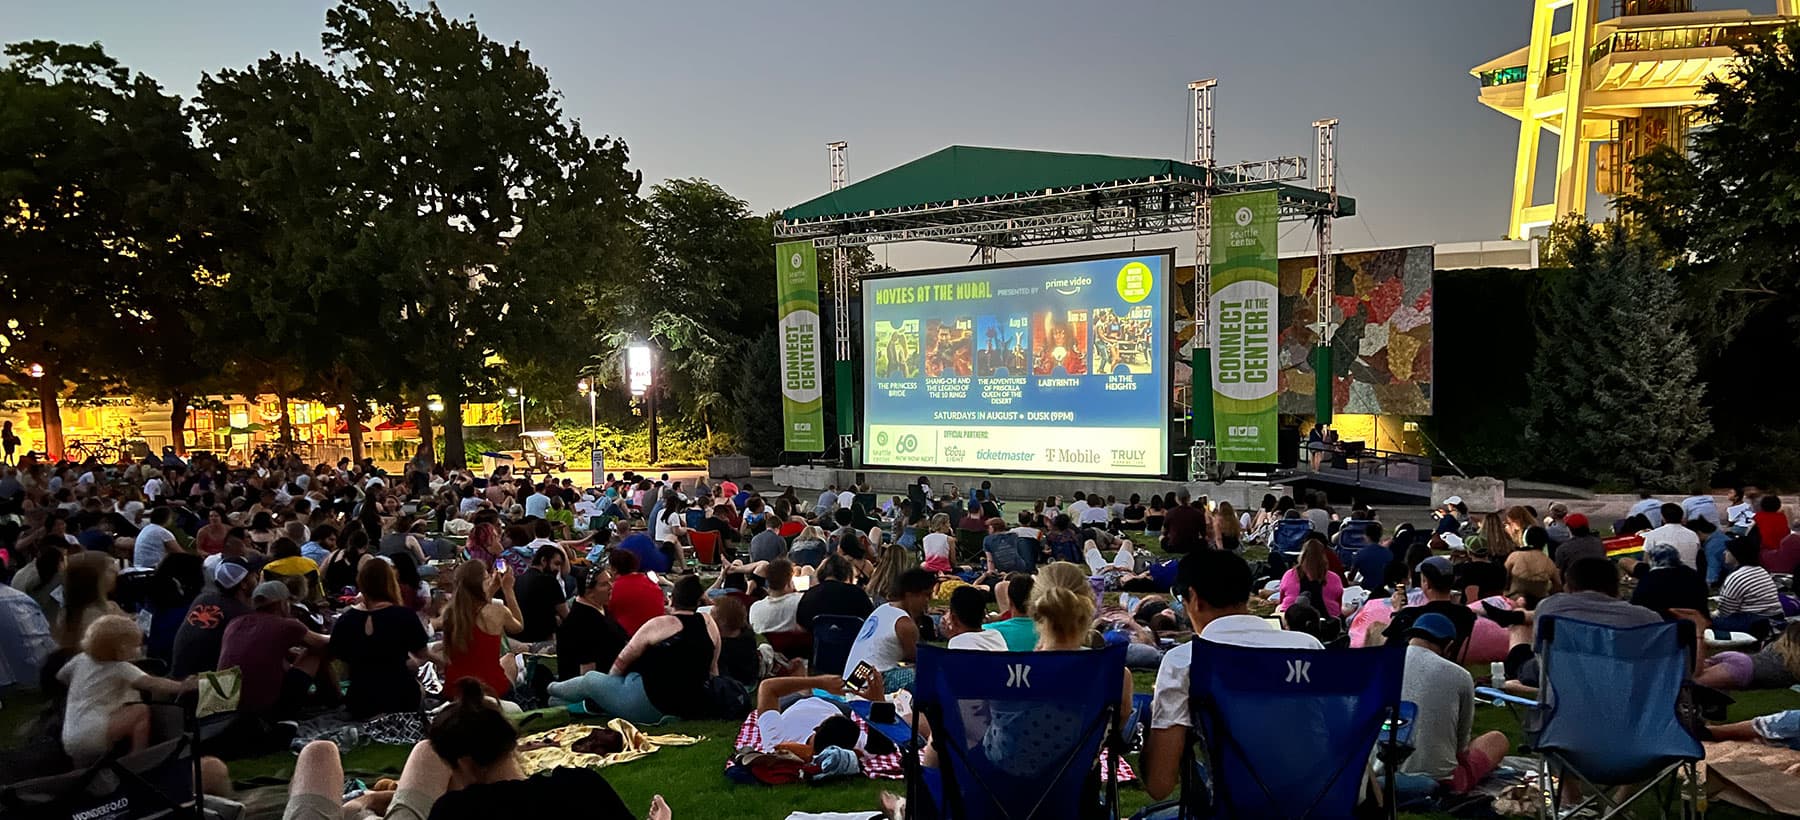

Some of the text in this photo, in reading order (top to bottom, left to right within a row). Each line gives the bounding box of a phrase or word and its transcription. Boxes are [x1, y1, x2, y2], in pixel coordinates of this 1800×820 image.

[1230, 227, 1258, 239] seattle
[1230, 238, 1256, 247] center
[876, 287, 915, 305] MOVIES
[917, 286, 930, 303] AT
[933, 284, 953, 302] THE
[957, 281, 993, 300] MURAL
[1045, 278, 1069, 290] prime
[1069, 277, 1092, 287] video
[1244, 298, 1268, 309] AT THE
[1009, 318, 1021, 328] Aug
[1218, 300, 1242, 383] CONNECT
[1244, 311, 1268, 383] CENTER
[785, 325, 801, 390] CONNECT
[800, 333, 816, 390] CENTER
[890, 382, 917, 390] PRINCESS
[1038, 378, 1080, 387] LABYRINTH
[1105, 383, 1137, 391] HEIGHTS
[933, 411, 1074, 422] SATURDAYS IN AUGUST DUSK (9PM)
[896, 434, 918, 454] 60
[976, 449, 1035, 461] ticketmaster
[1058, 448, 1101, 464] Mobile
[1111, 449, 1146, 460] TRULY
[72, 797, 128, 820] WONDERFOLD
